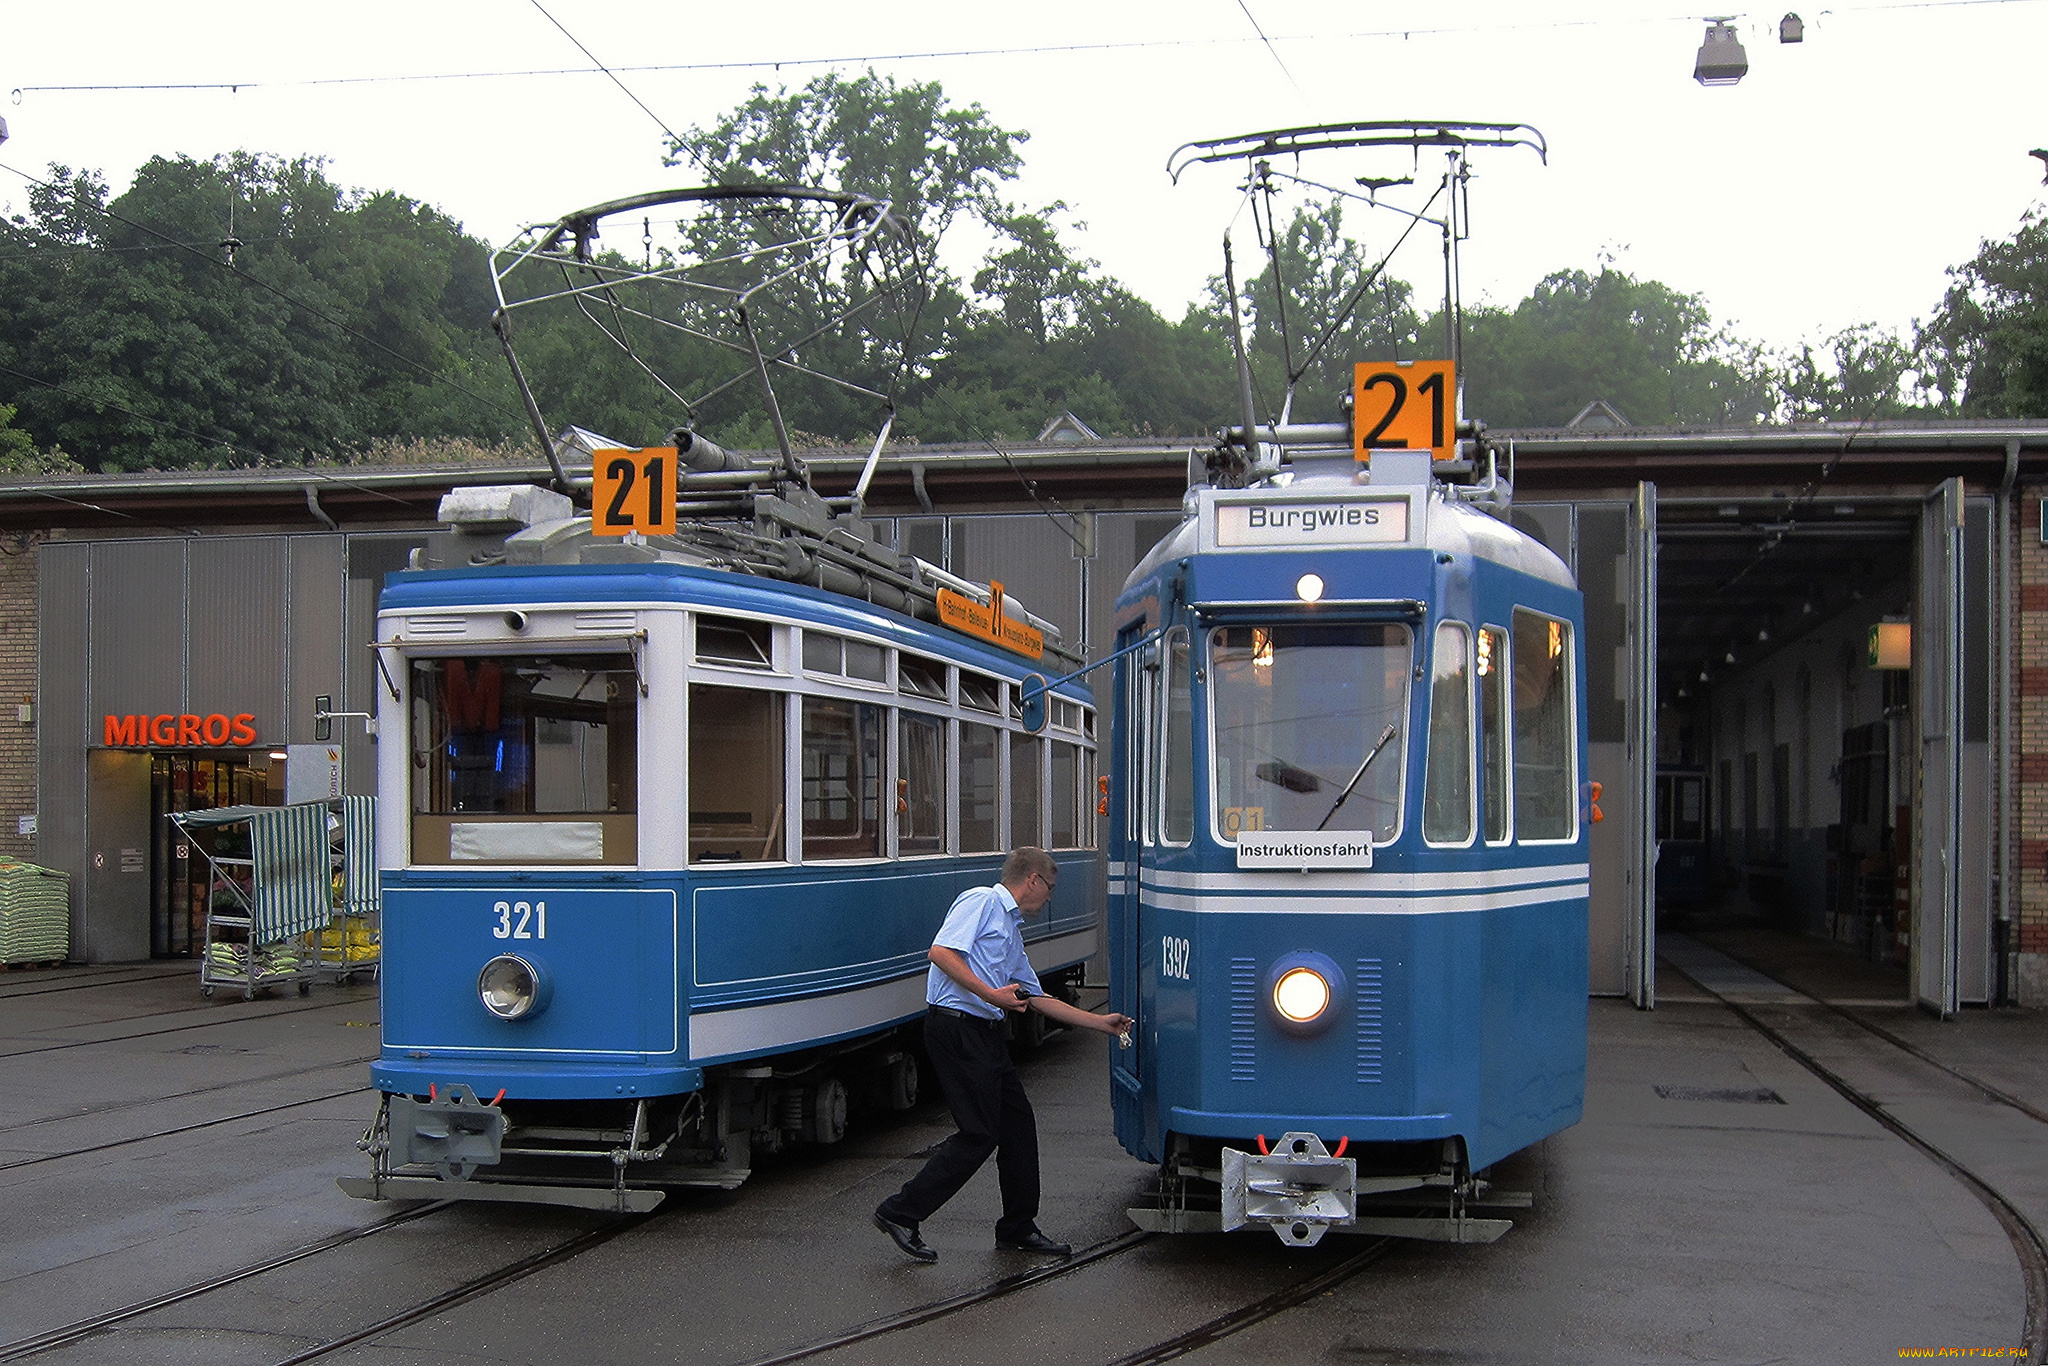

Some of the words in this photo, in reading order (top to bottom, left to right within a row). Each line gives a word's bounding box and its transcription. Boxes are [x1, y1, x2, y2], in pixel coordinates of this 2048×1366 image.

[1362, 371, 1445, 450] 21
[605, 457, 663, 526] 21
[1249, 505, 1380, 531] Burgwies
[991, 588, 1003, 637] 21
[103, 713, 257, 746] MIGROS
[1240, 843, 1369, 857] Instruktionsfahrt
[492, 901, 546, 939] 321
[1162, 935, 1190, 980] 1392
